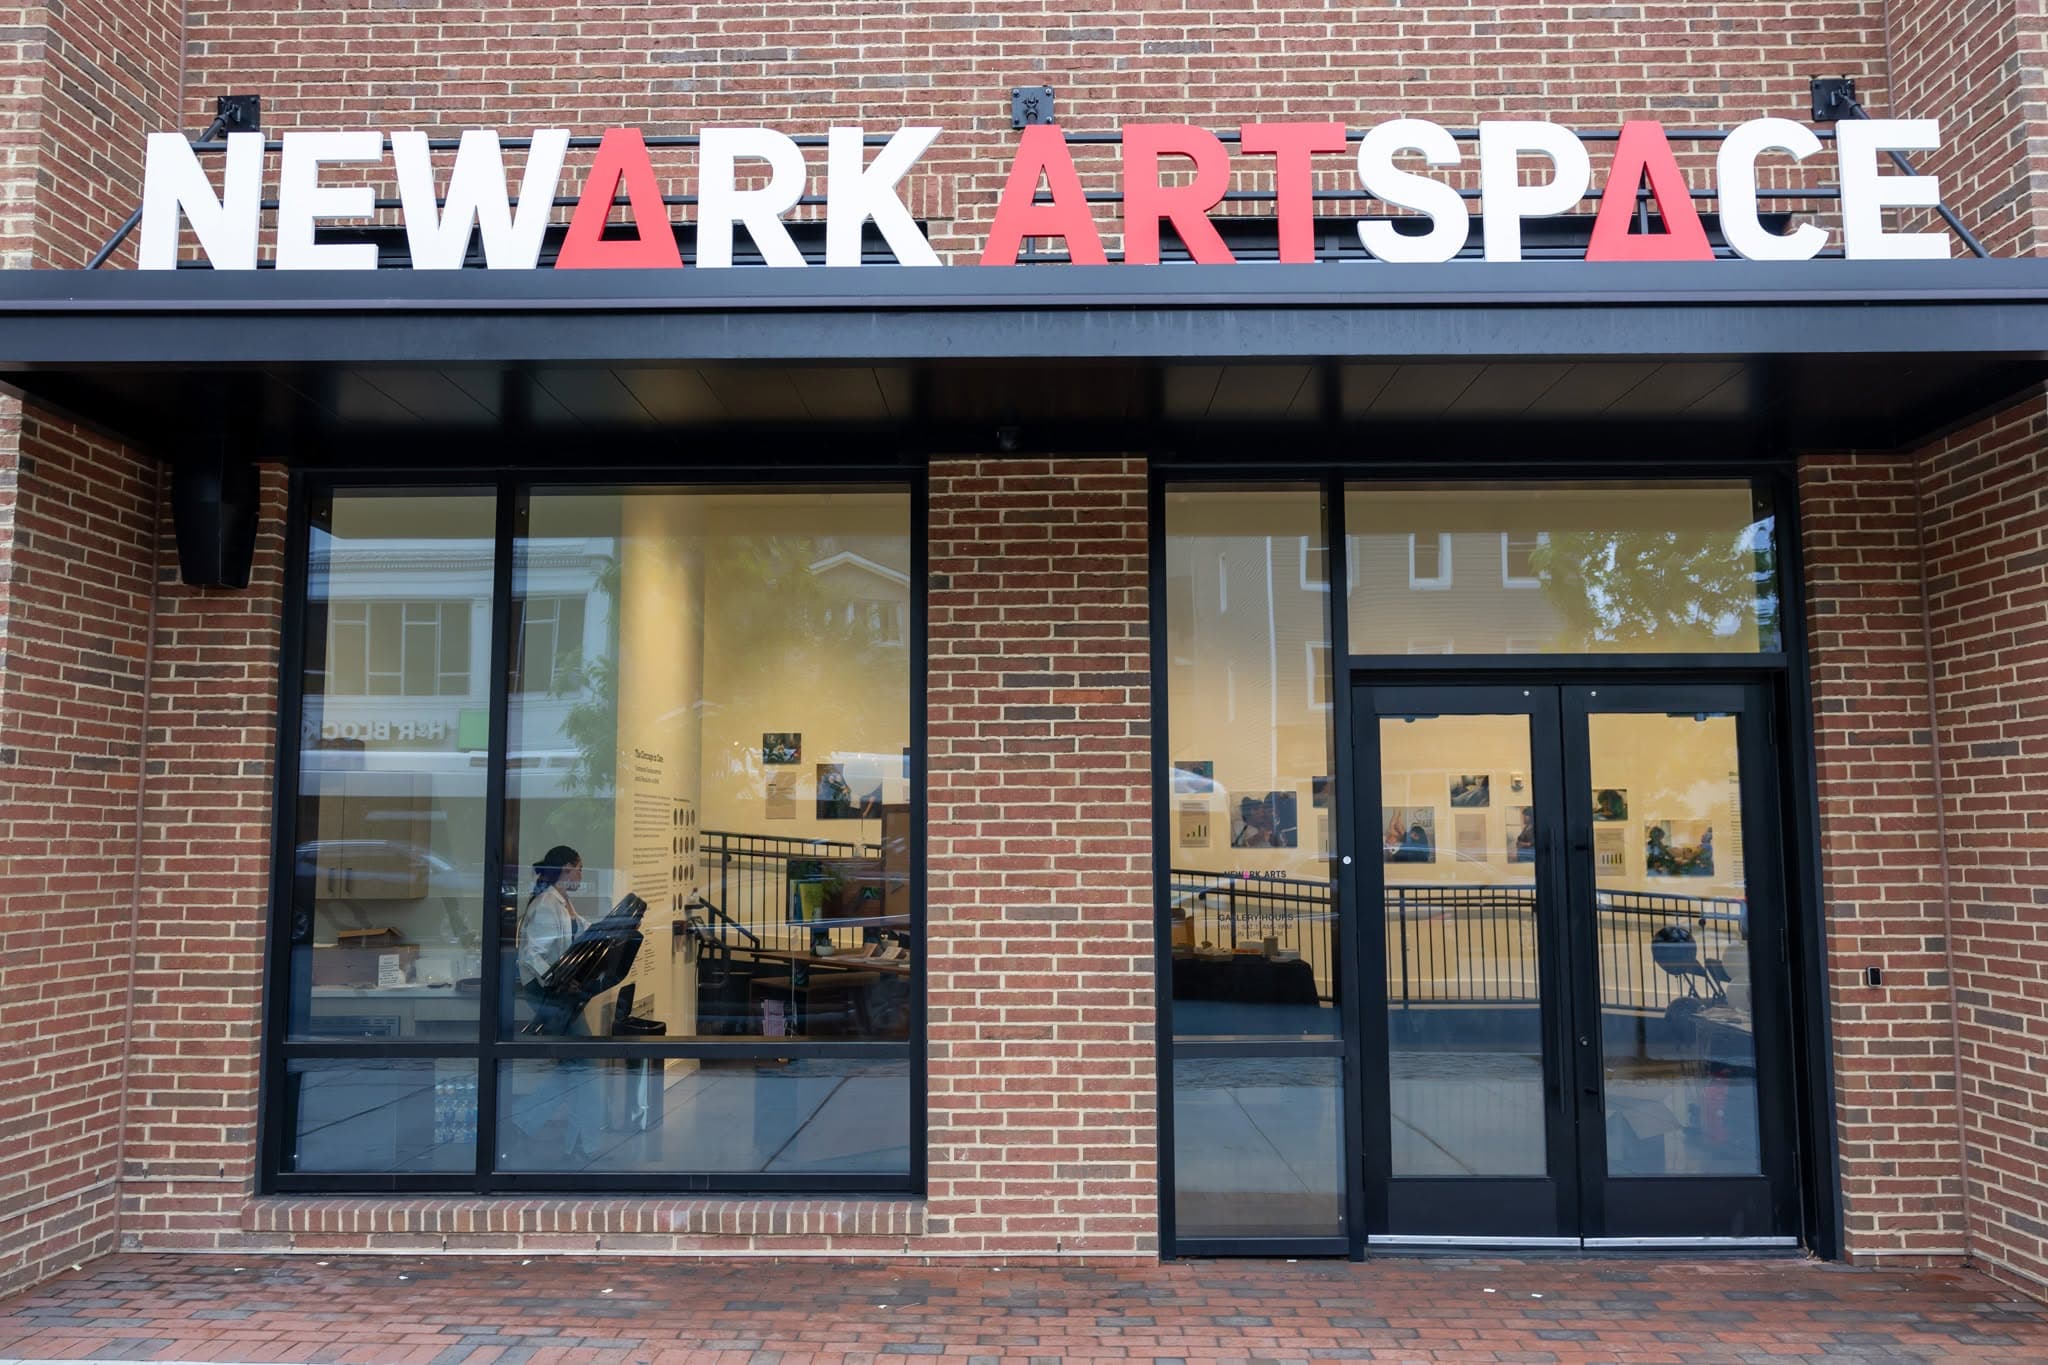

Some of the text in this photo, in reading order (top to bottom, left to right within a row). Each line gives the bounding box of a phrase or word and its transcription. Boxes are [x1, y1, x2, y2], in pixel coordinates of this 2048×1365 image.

[138, 126, 943, 271] NEWARK
[1264, 870, 1287, 879] ARTS
[1218, 913, 1259, 921] GALERY
